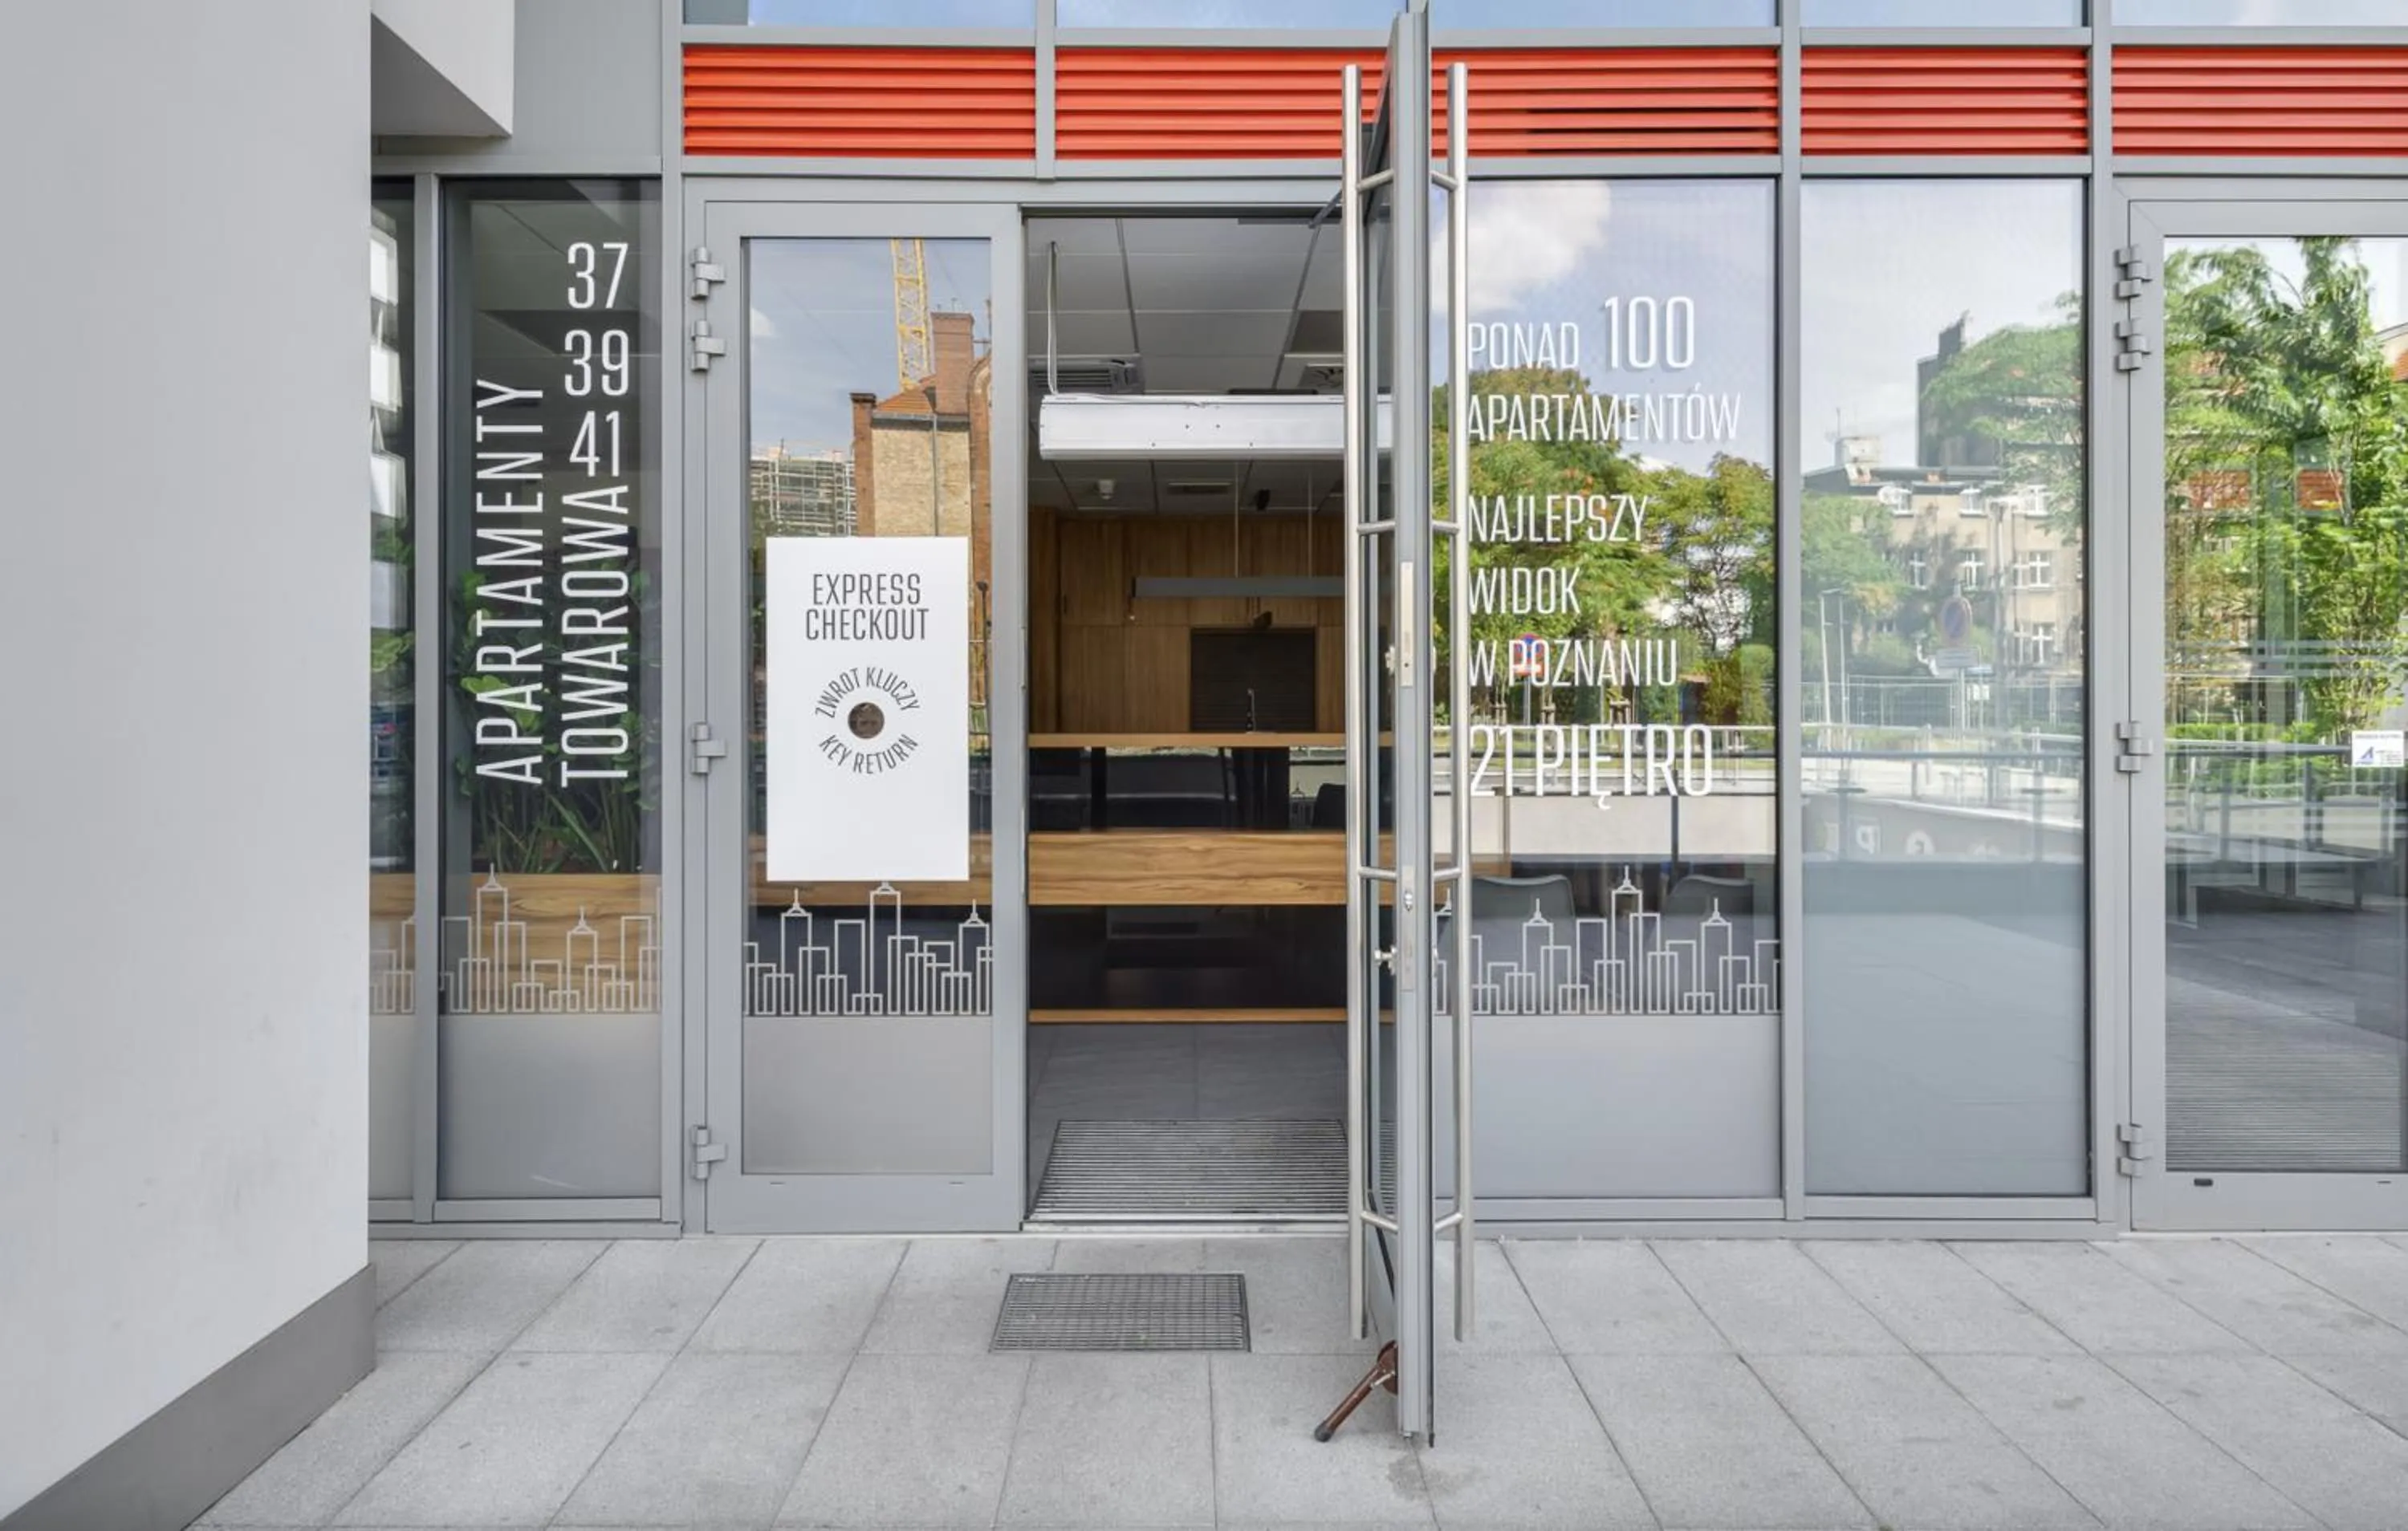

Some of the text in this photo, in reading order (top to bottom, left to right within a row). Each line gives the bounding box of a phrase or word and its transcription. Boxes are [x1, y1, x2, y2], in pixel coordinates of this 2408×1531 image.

[567, 242, 628, 309] 37
[1467, 295, 1694, 369] PONAD 100
[563, 329, 629, 396] 39
[1468, 383, 1741, 441] APARTAMENTÓW
[569, 410, 620, 477] 41
[1468, 494, 1649, 542] NAJLEPSZY
[475, 379, 543, 785] APARTAMENTY
[813, 574, 921, 605] EXPRESS
[1469, 567, 1581, 615] WIDOK
[561, 485, 628, 788] TOWAROWA
[806, 608, 929, 640] CHECKOUT
[815, 667, 920, 718] ZWROT KLUCZY
[1470, 640, 1678, 687] W POZNANIU
[819, 733, 918, 774] KEY RETURN
[1470, 724, 1713, 810] 21 PIĘTRO
